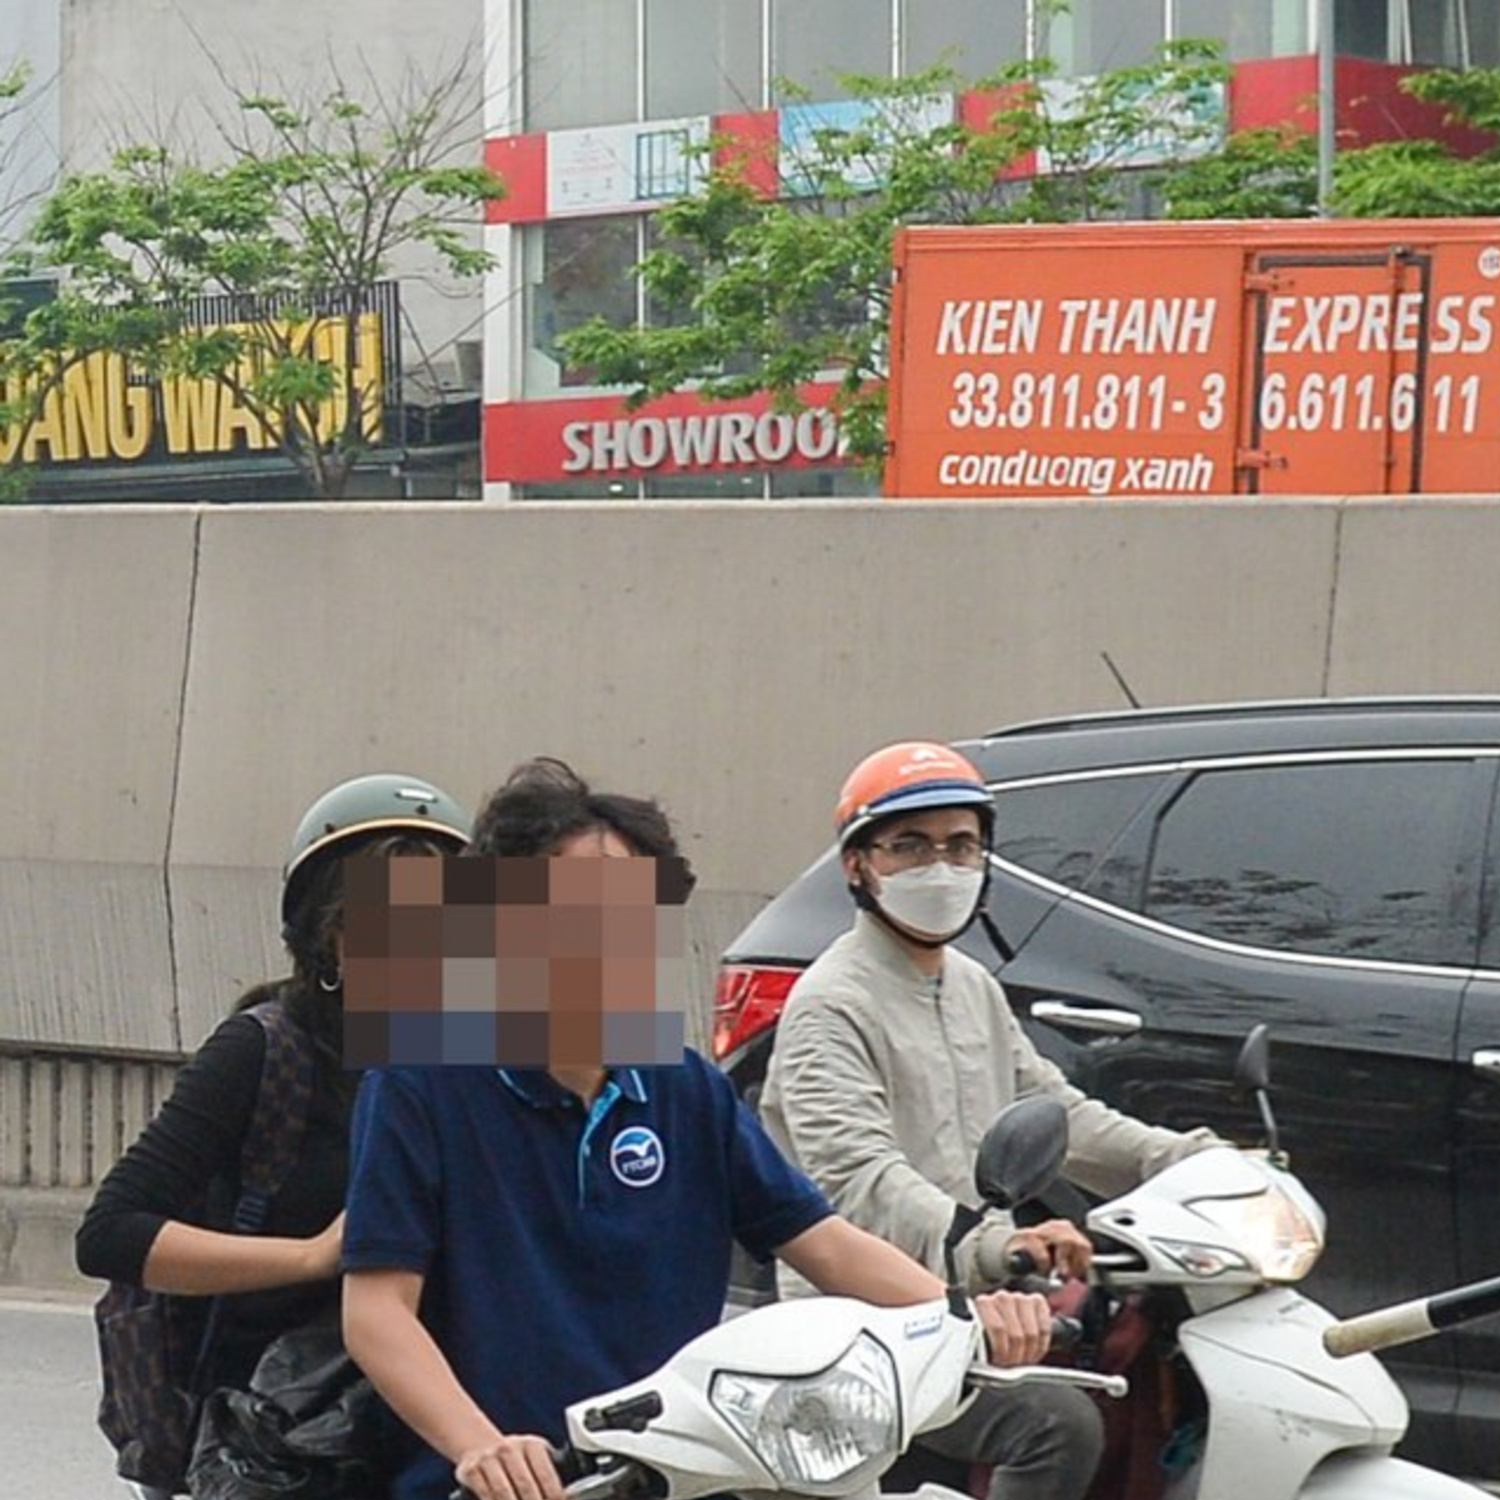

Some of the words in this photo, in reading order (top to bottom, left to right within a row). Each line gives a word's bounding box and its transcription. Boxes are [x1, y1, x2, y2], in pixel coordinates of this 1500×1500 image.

[936, 299, 1043, 355] KIEN
[1058, 298, 1216, 354] THANH
[1262, 293, 1496, 354] EXPRESS
[561, 407, 849, 472] SHOWROO
[1119, 453, 1213, 490] xanh
